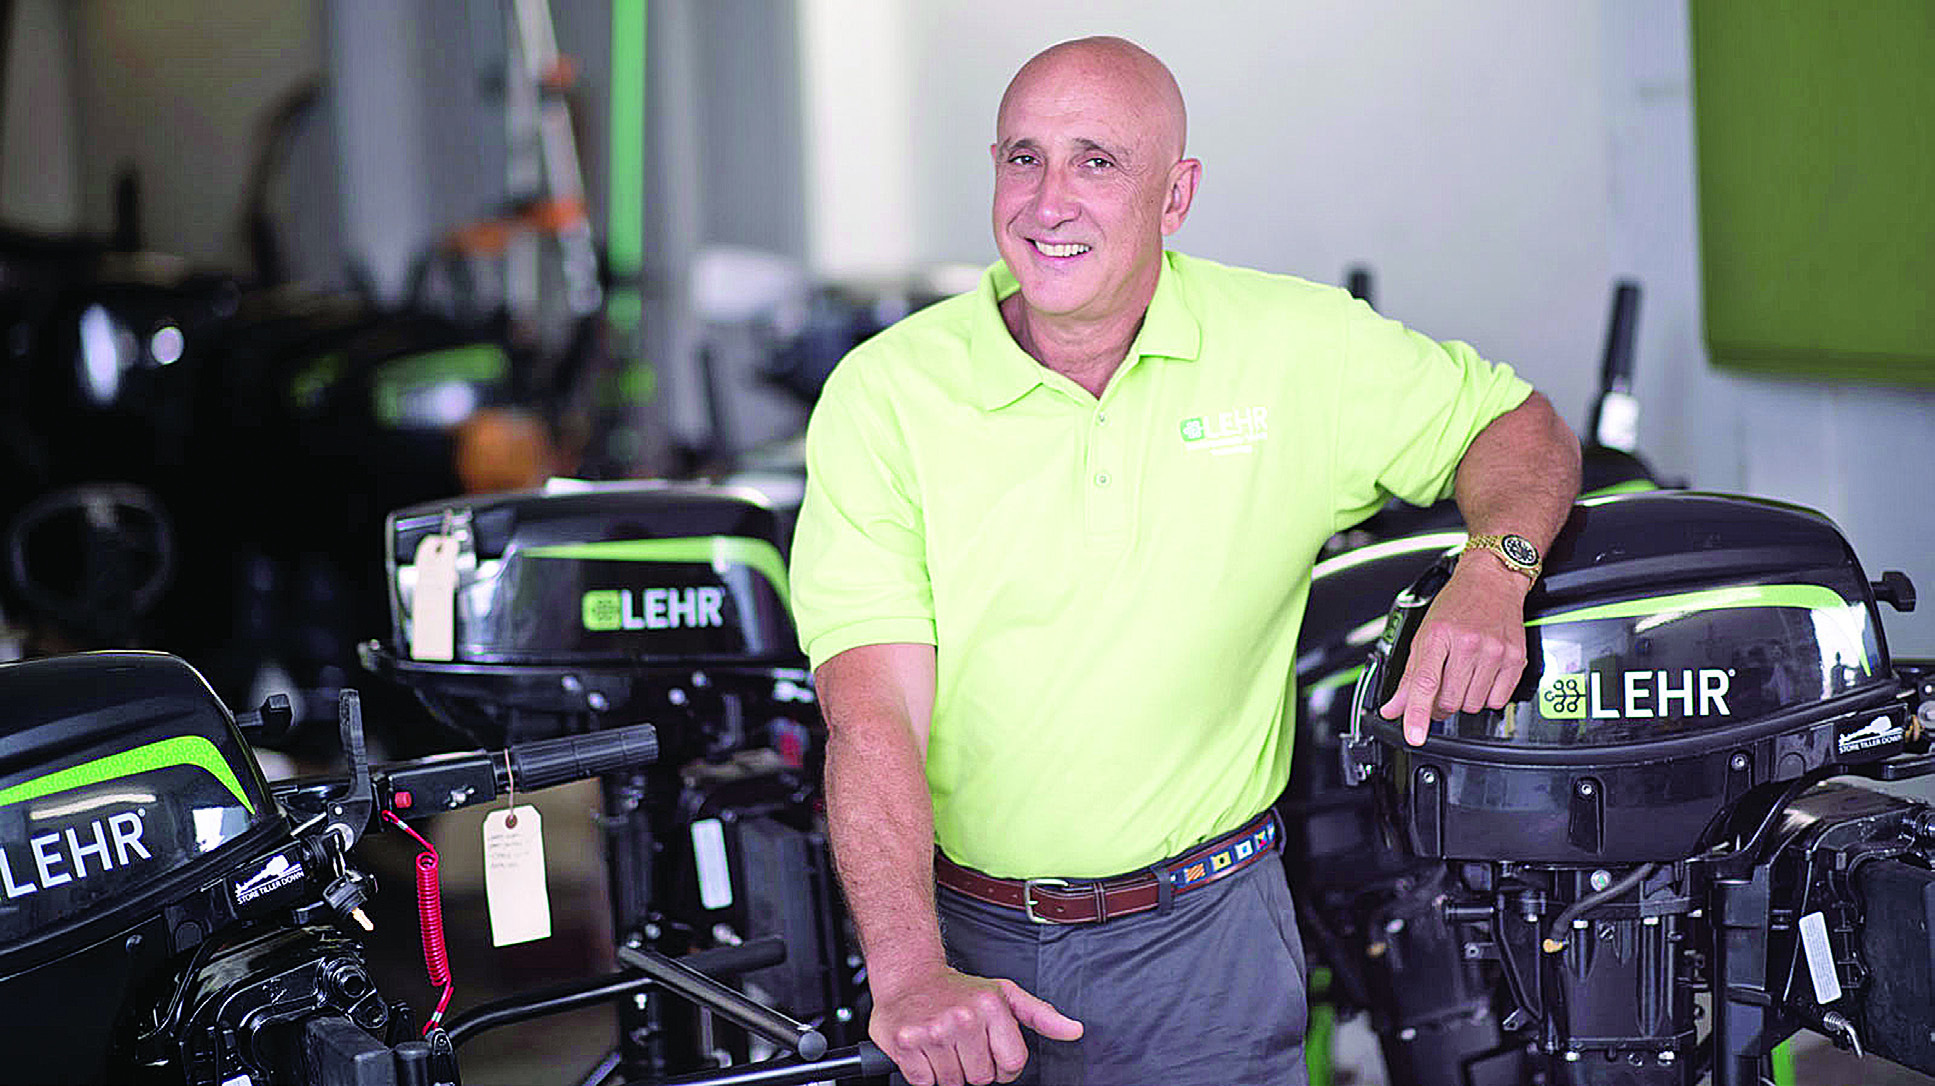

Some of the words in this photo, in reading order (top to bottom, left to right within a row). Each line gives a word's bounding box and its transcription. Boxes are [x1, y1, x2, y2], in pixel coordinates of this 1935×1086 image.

[1203, 406, 1268, 438] LEHR
[621, 587, 723, 629] LEHR
[1591, 669, 1731, 718] LEHR
[0, 812, 152, 898] LEHR
[237, 889, 260, 904] STORE
[259, 880, 282, 895] TILLER
[281, 870, 305, 886] DOWN
